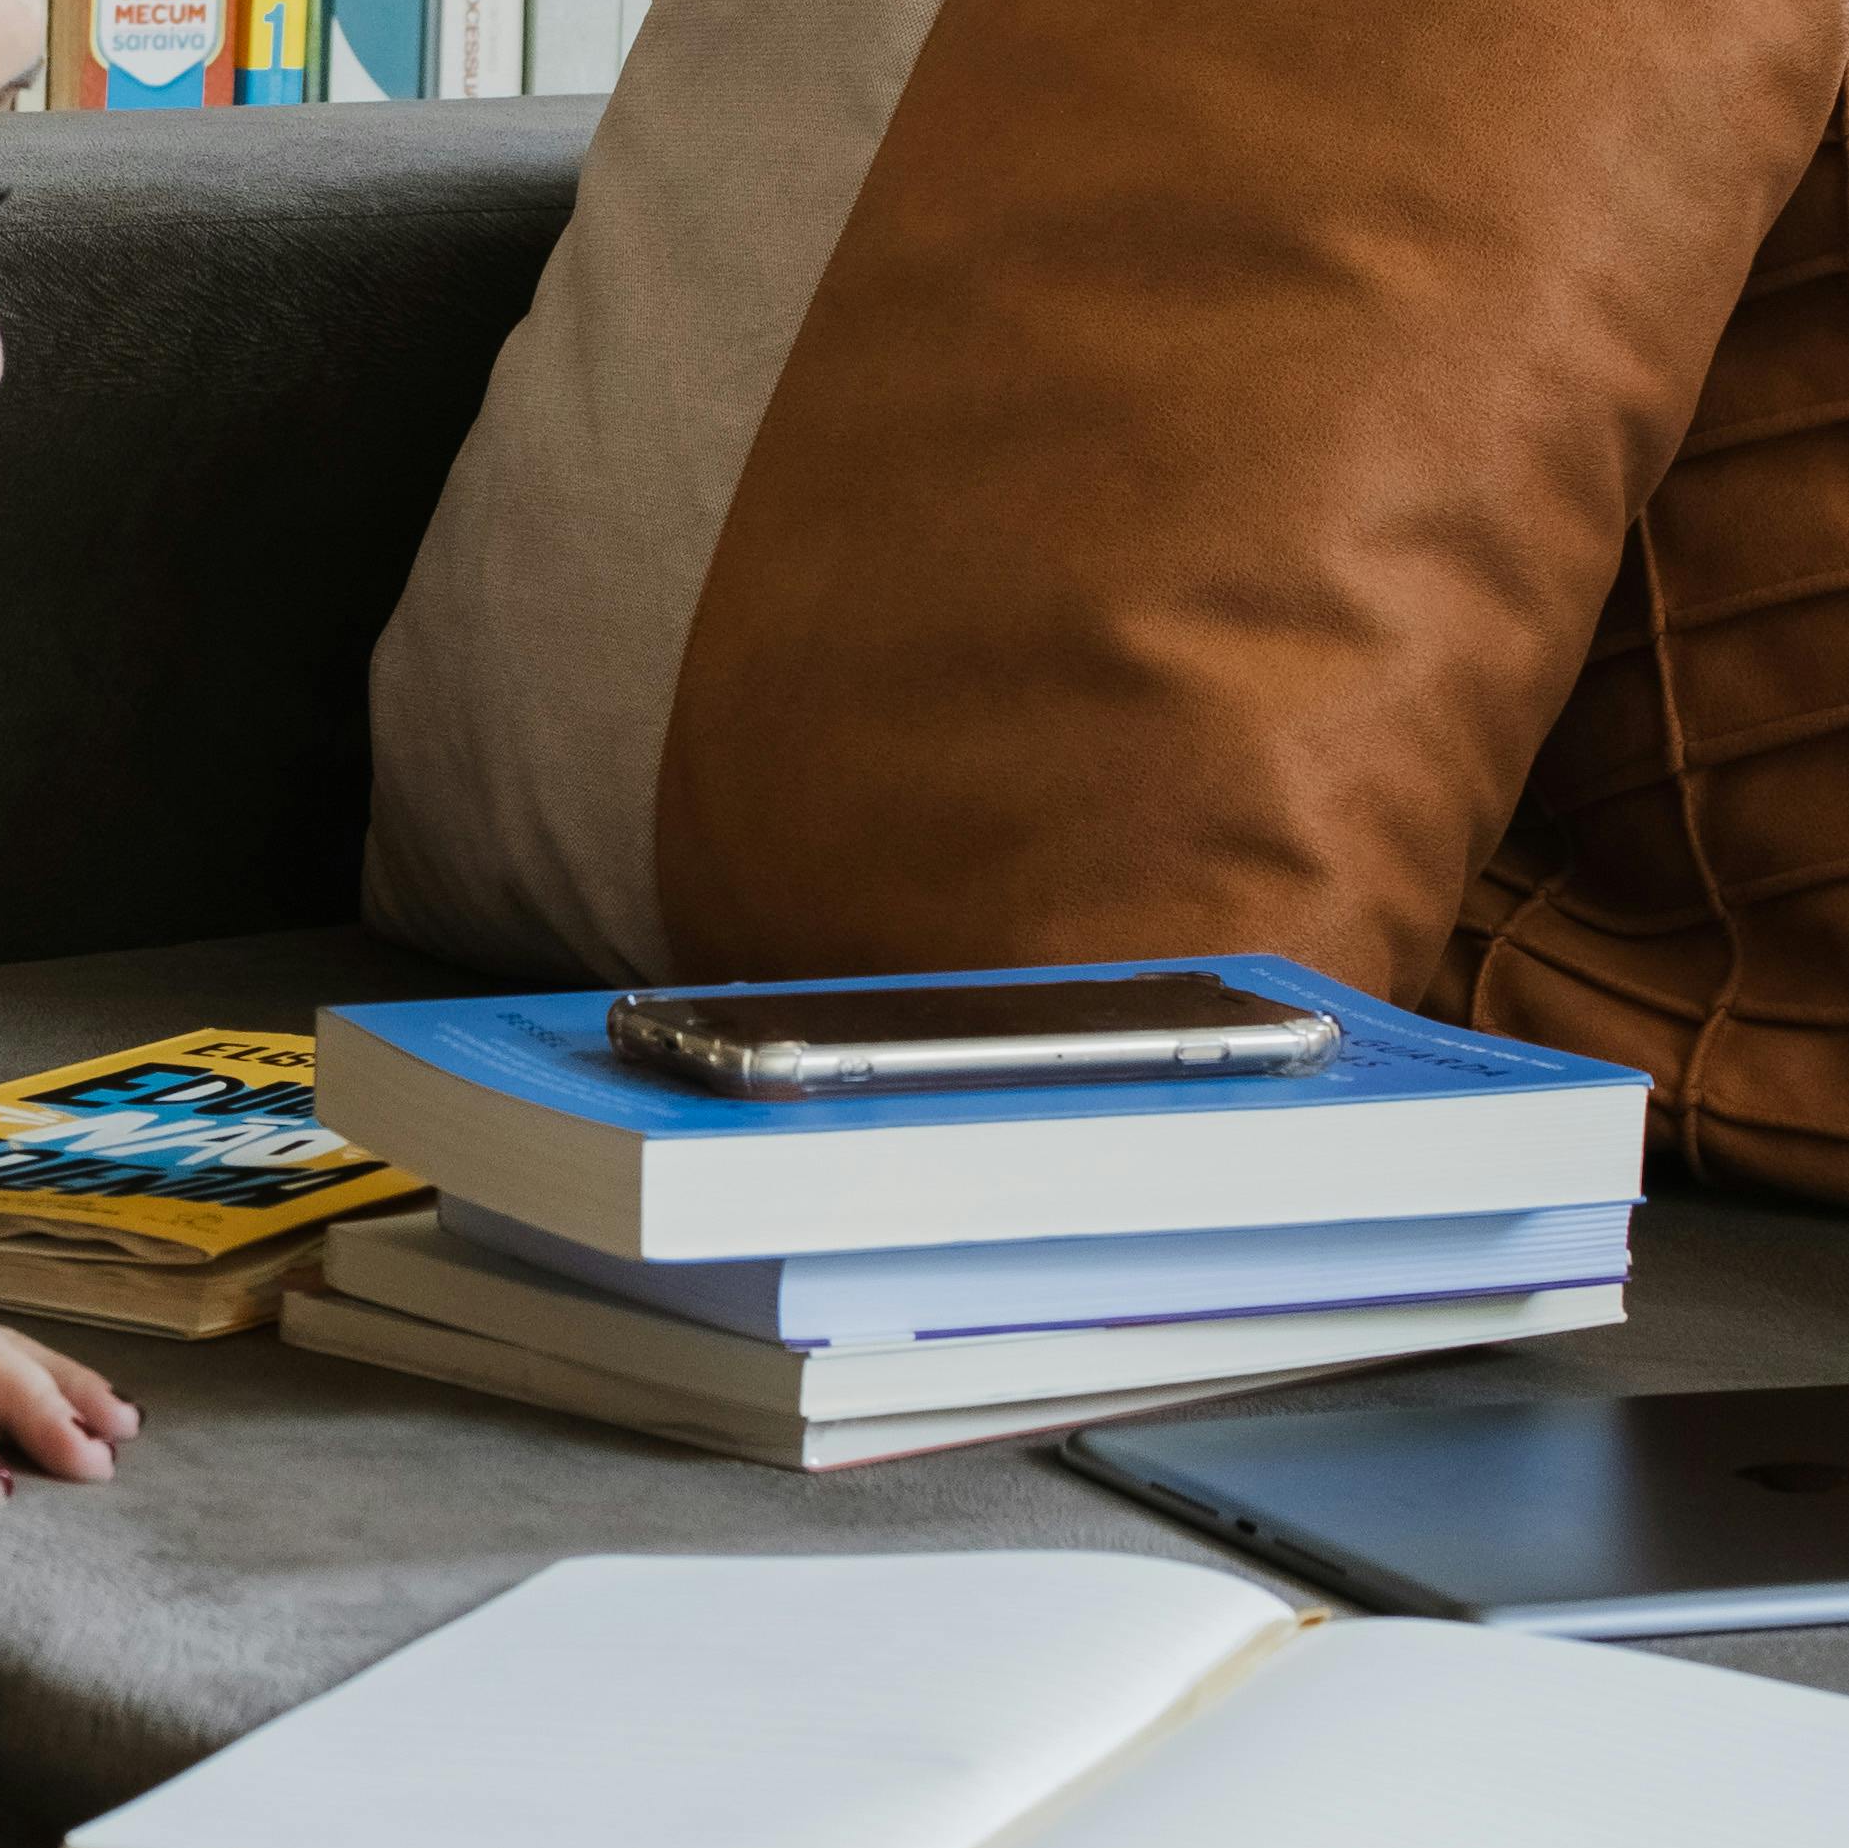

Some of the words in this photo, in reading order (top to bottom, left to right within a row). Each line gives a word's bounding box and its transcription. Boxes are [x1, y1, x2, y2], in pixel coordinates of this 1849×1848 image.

[114, 4, 207, 24] MECUM
[112, 27, 206, 51] saraiva
[263, 2, 286, 69] 1
[1351, 1038, 1510, 1077] GUARDA
[11, 1111, 350, 1168] NÃO
